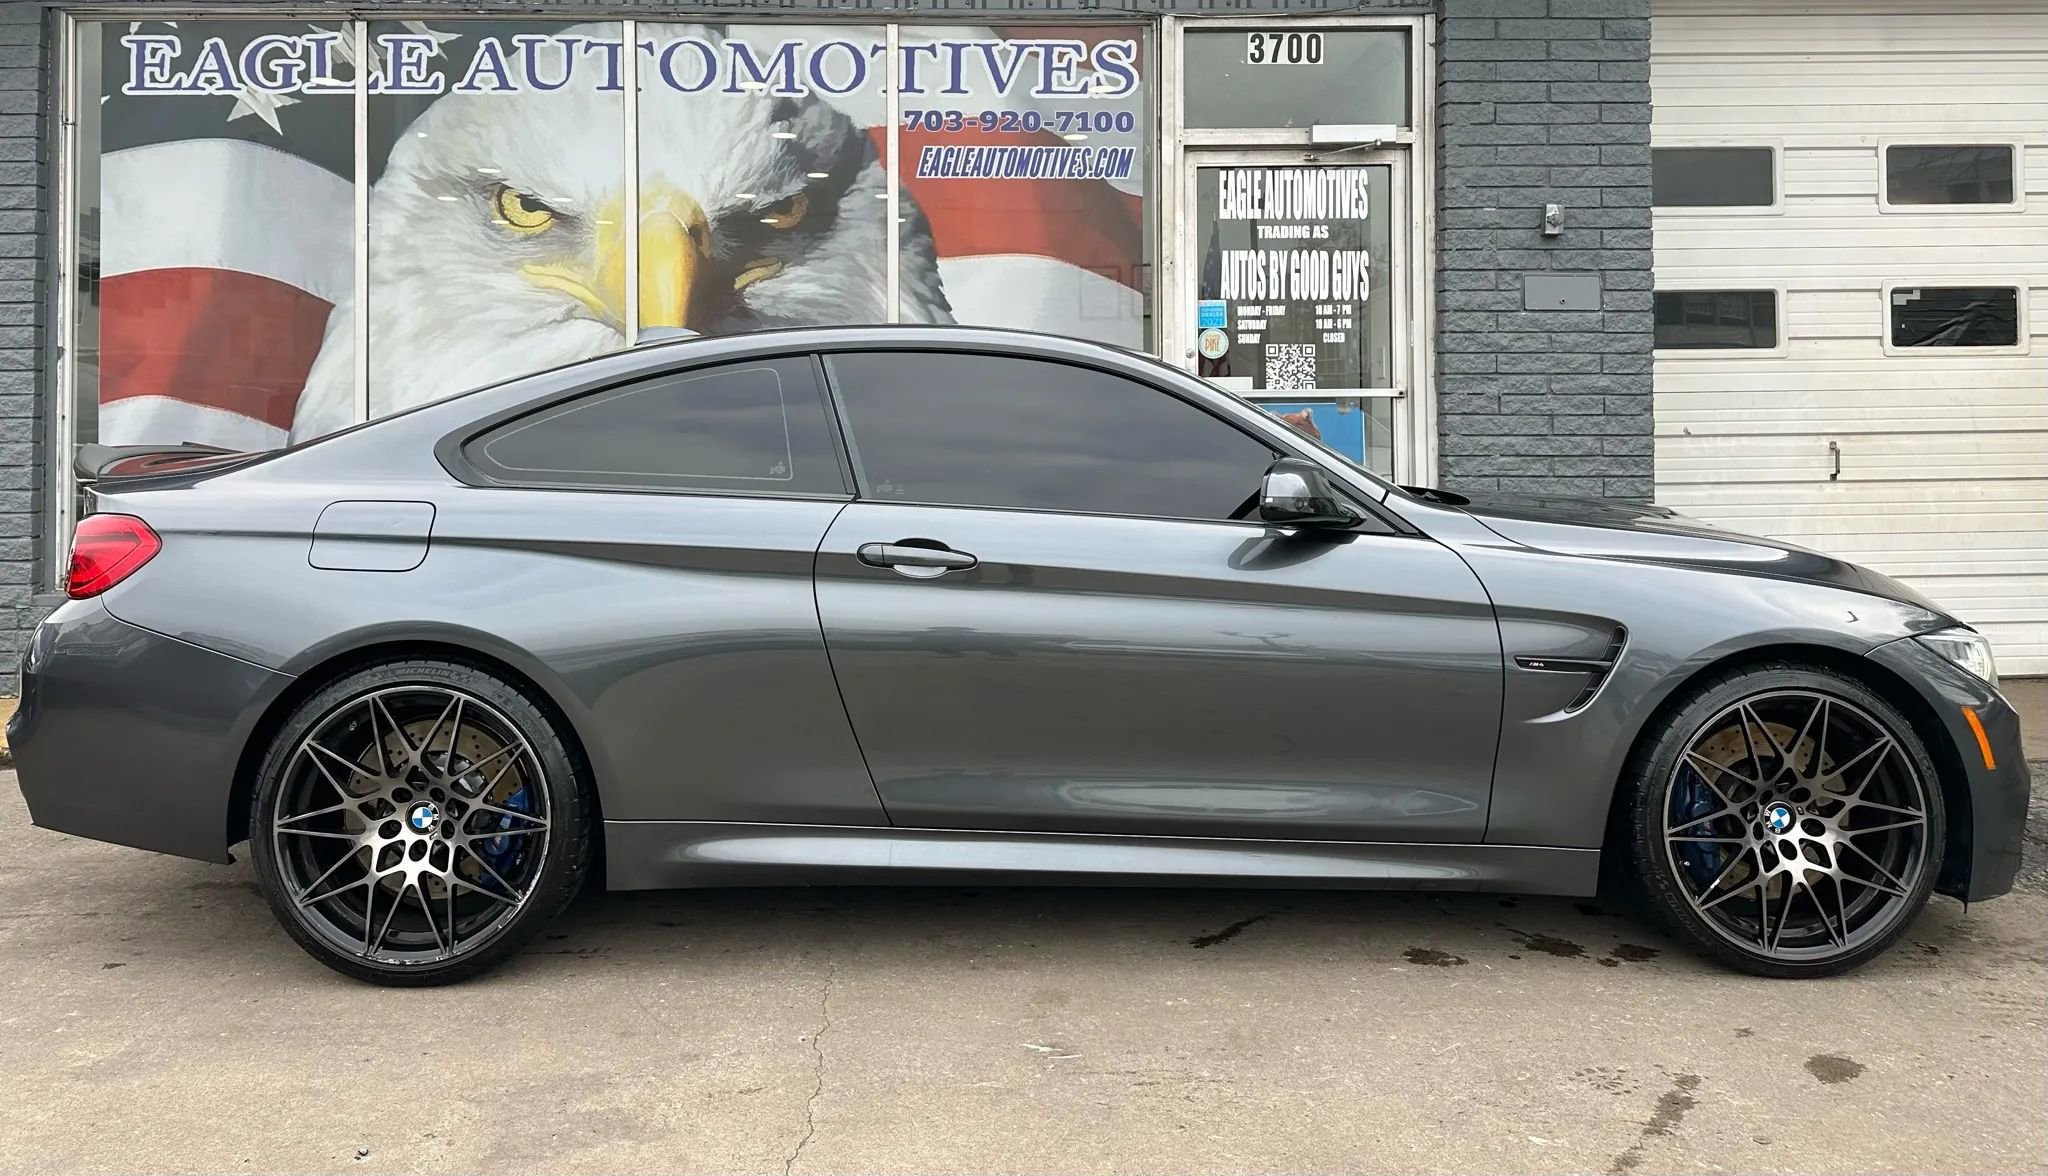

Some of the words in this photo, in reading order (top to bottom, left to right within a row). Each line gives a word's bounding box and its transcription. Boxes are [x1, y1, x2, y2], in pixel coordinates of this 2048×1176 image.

[1249, 33, 1322, 63] 3700
[121, 34, 444, 95] EAGLE
[455, 34, 1139, 99] AUTOMOTIVES
[904, 110, 1135, 133] 703-920-7100
[916, 146, 1136, 180] EAGLEAUTOMOTIVES.COM
[1219, 170, 1262, 220] EAGLE
[1264, 168, 1369, 220] AUTOMOTIVES
[1257, 225, 1310, 239] TRADING
[1312, 225, 1329, 238] AS
[1220, 250, 1266, 301] AUTOS
[1269, 250, 1288, 300] BY
[1290, 249, 1329, 301] GOOD
[1332, 249, 1370, 301] GUYS
[1237, 305, 1262, 316] MONDAY
[1265, 305, 1286, 316] FRIDAY
[1315, 305, 1323, 315] 10
[1323, 305, 1333, 315] AM
[1336, 305, 1341, 315] 7
[1342, 305, 1352, 315] PM
[1237, 319, 1268, 330] SATURDAY
[1315, 319, 1323, 329] 10
[1323, 319, 1333, 329] AM
[1342, 318, 1352, 329] PM
[1238, 333, 1261, 344] SUNDAY
[1323, 332, 1345, 343] CLOSED
[396, 667, 451, 678] MICHELIN
